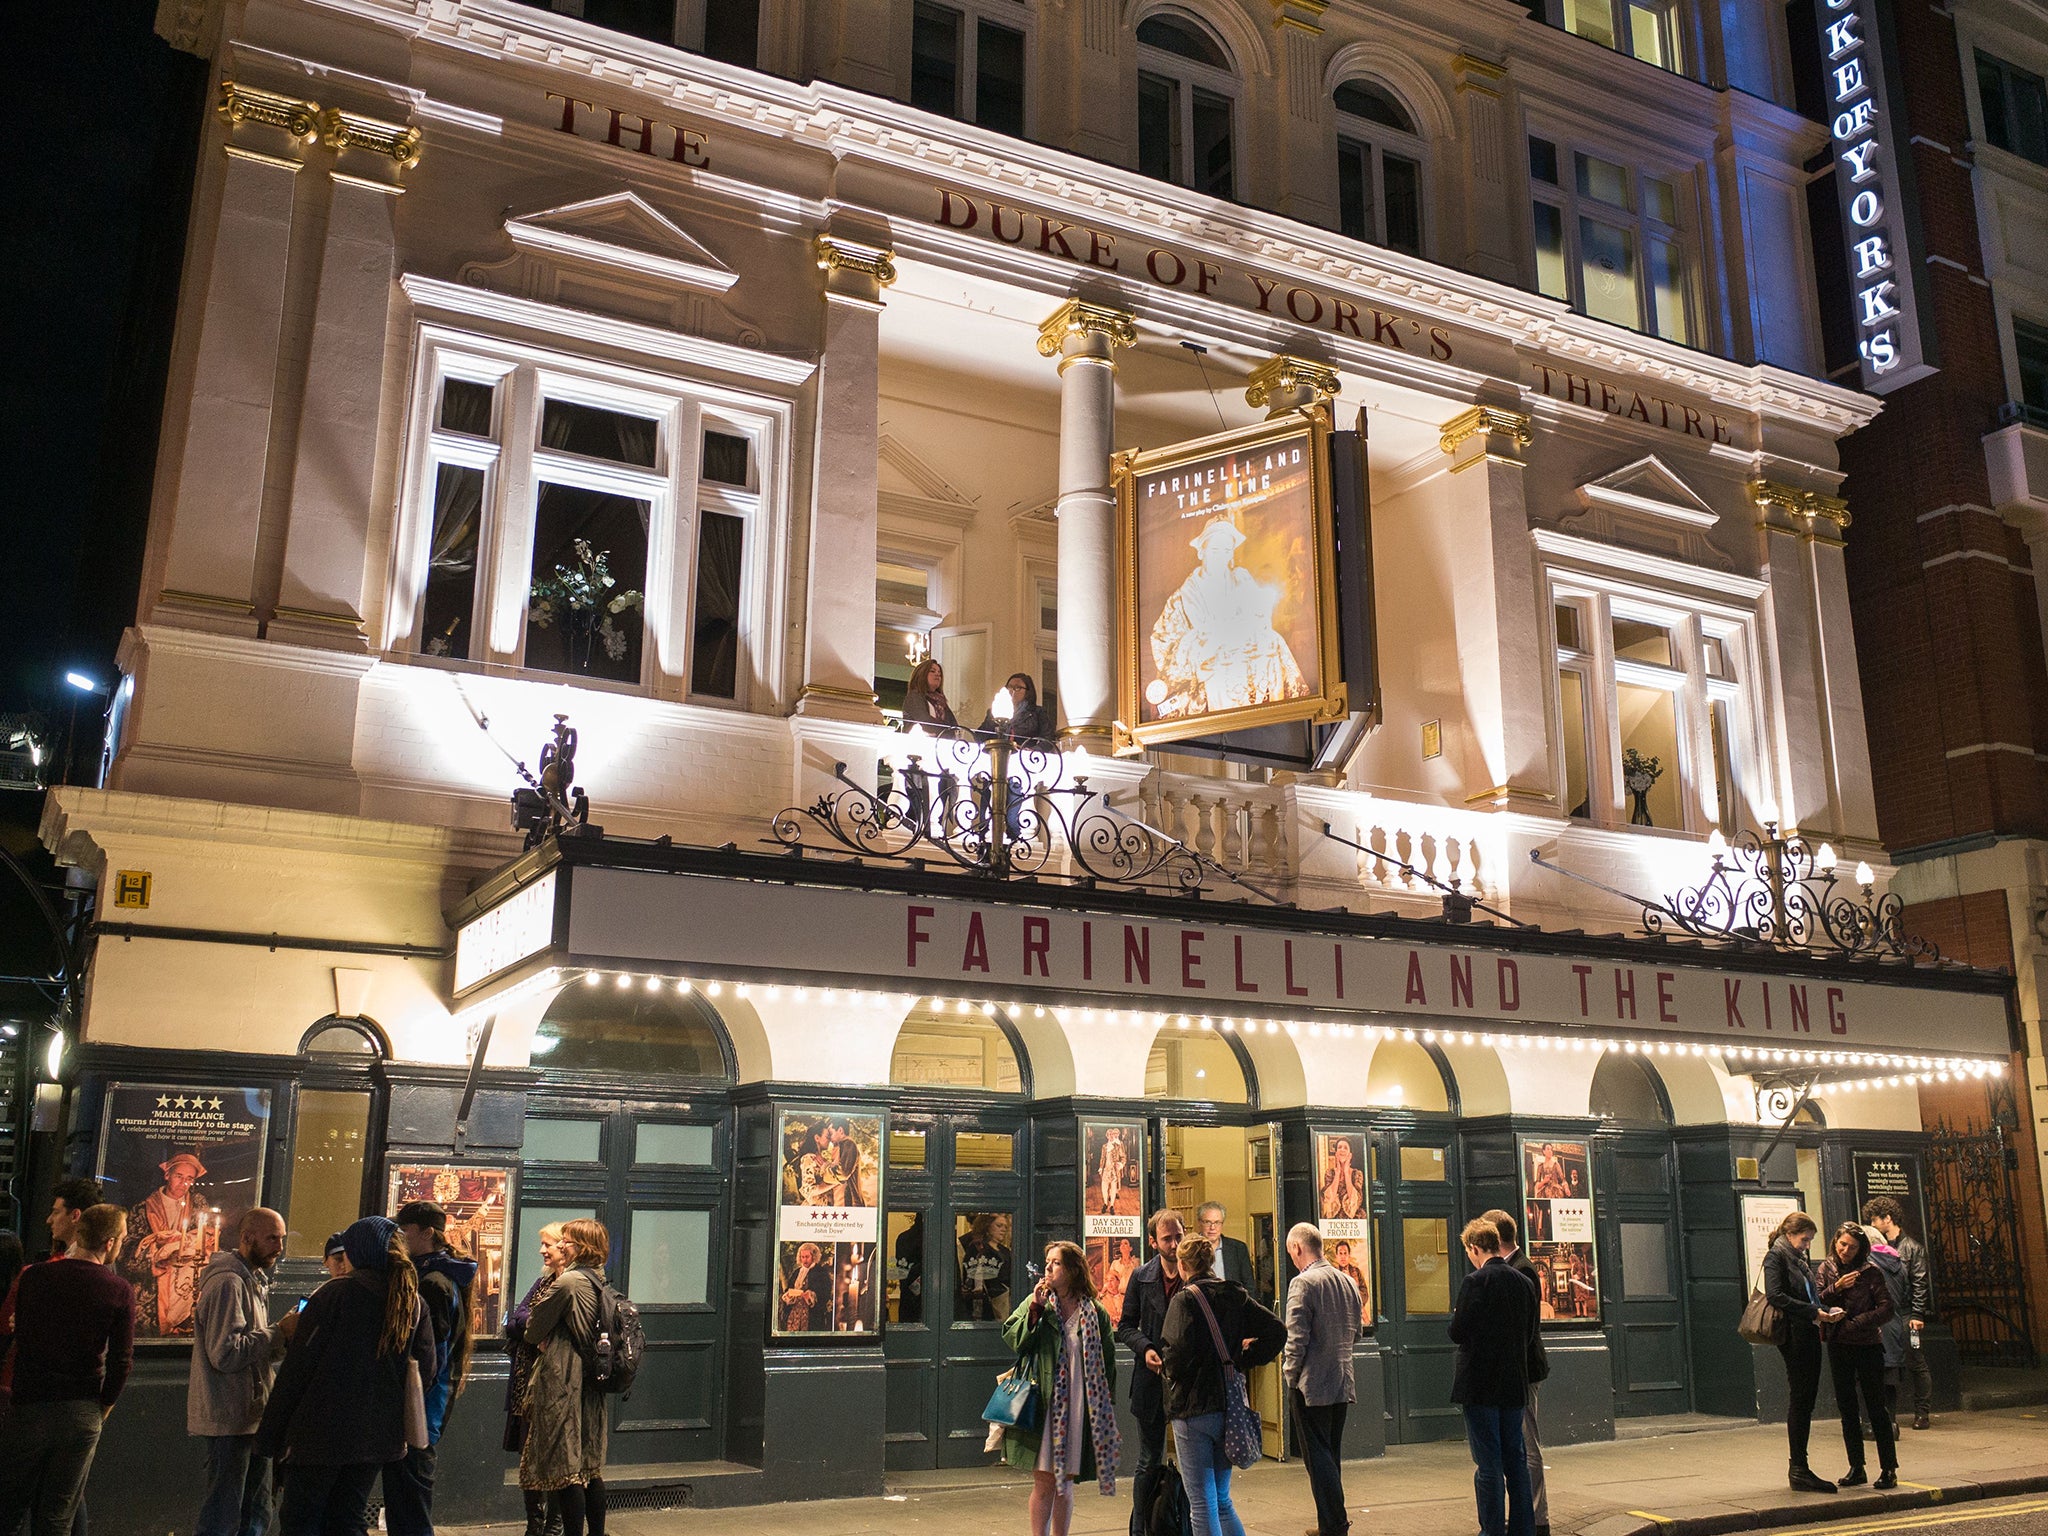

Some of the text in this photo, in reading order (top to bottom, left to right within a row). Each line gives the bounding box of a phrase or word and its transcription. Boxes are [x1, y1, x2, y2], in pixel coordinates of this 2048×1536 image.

[544, 90, 710, 170] THE
[1834, 98, 1873, 140] OF
[1842, 138, 1896, 373] YORK'S
[934, 186, 1454, 361] DUKE OF YORK'S
[1532, 363, 1733, 446] THEATRE
[1148, 448, 1301, 498] FARINELLI AND
[1177, 473, 1271, 510] THE KING
[129, 877, 139, 886] 12
[127, 894, 138, 903] 15
[907, 905, 1847, 1035] FARINELLI AND THE KING
[115, 1118, 257, 1131] returns triumphantly to the stage.
[183, 1111, 225, 1121] RYLANCE
[833, 1221, 856, 1229] directed
[856, 1221, 864, 1229] by
[1092, 1218, 1134, 1226] DAY SEATS
[1092, 1227, 1134, 1235] AVAILABLE
[1327, 1221, 1358, 1229] TICKETS
